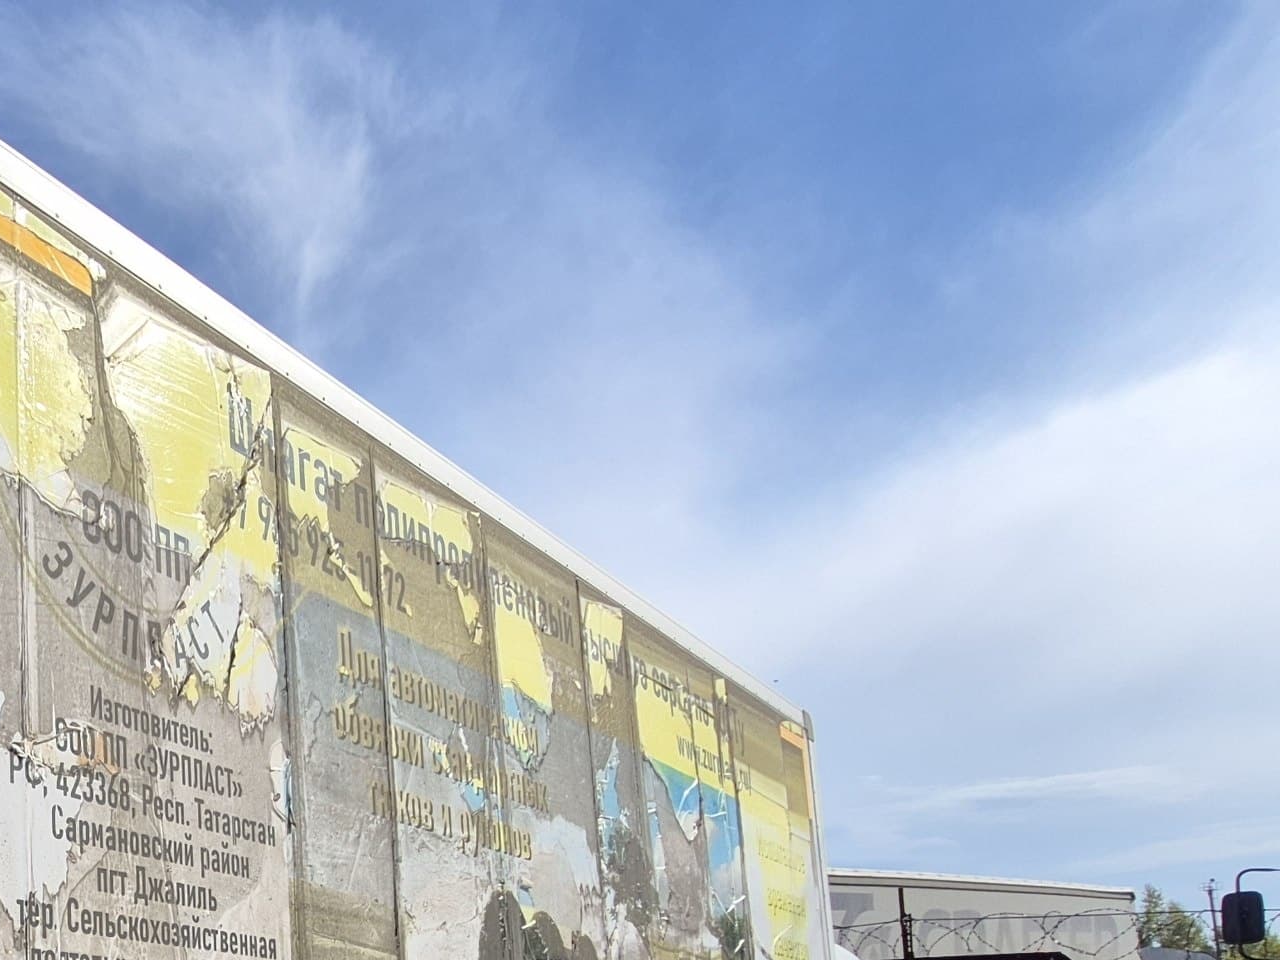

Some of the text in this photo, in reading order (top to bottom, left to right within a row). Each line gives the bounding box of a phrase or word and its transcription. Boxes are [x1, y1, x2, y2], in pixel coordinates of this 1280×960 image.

[155, 523, 191, 586] ПП
[337, 627, 383, 690] Для
[90, 685, 214, 755] Изготовитель:
[55, 717, 243, 799] ООО ПП «ЗУРПЛАСТ»
[56, 762, 137, 819] 423368,
[142, 783, 190, 826] Респ.
[194, 797, 276, 848] Татарстан
[441, 803, 453, 838] и
[51, 804, 251, 879] Сармановский район
[97, 865, 218, 912] пгт Джалиль
[68, 897, 278, 960] Сельскохозяйственная
